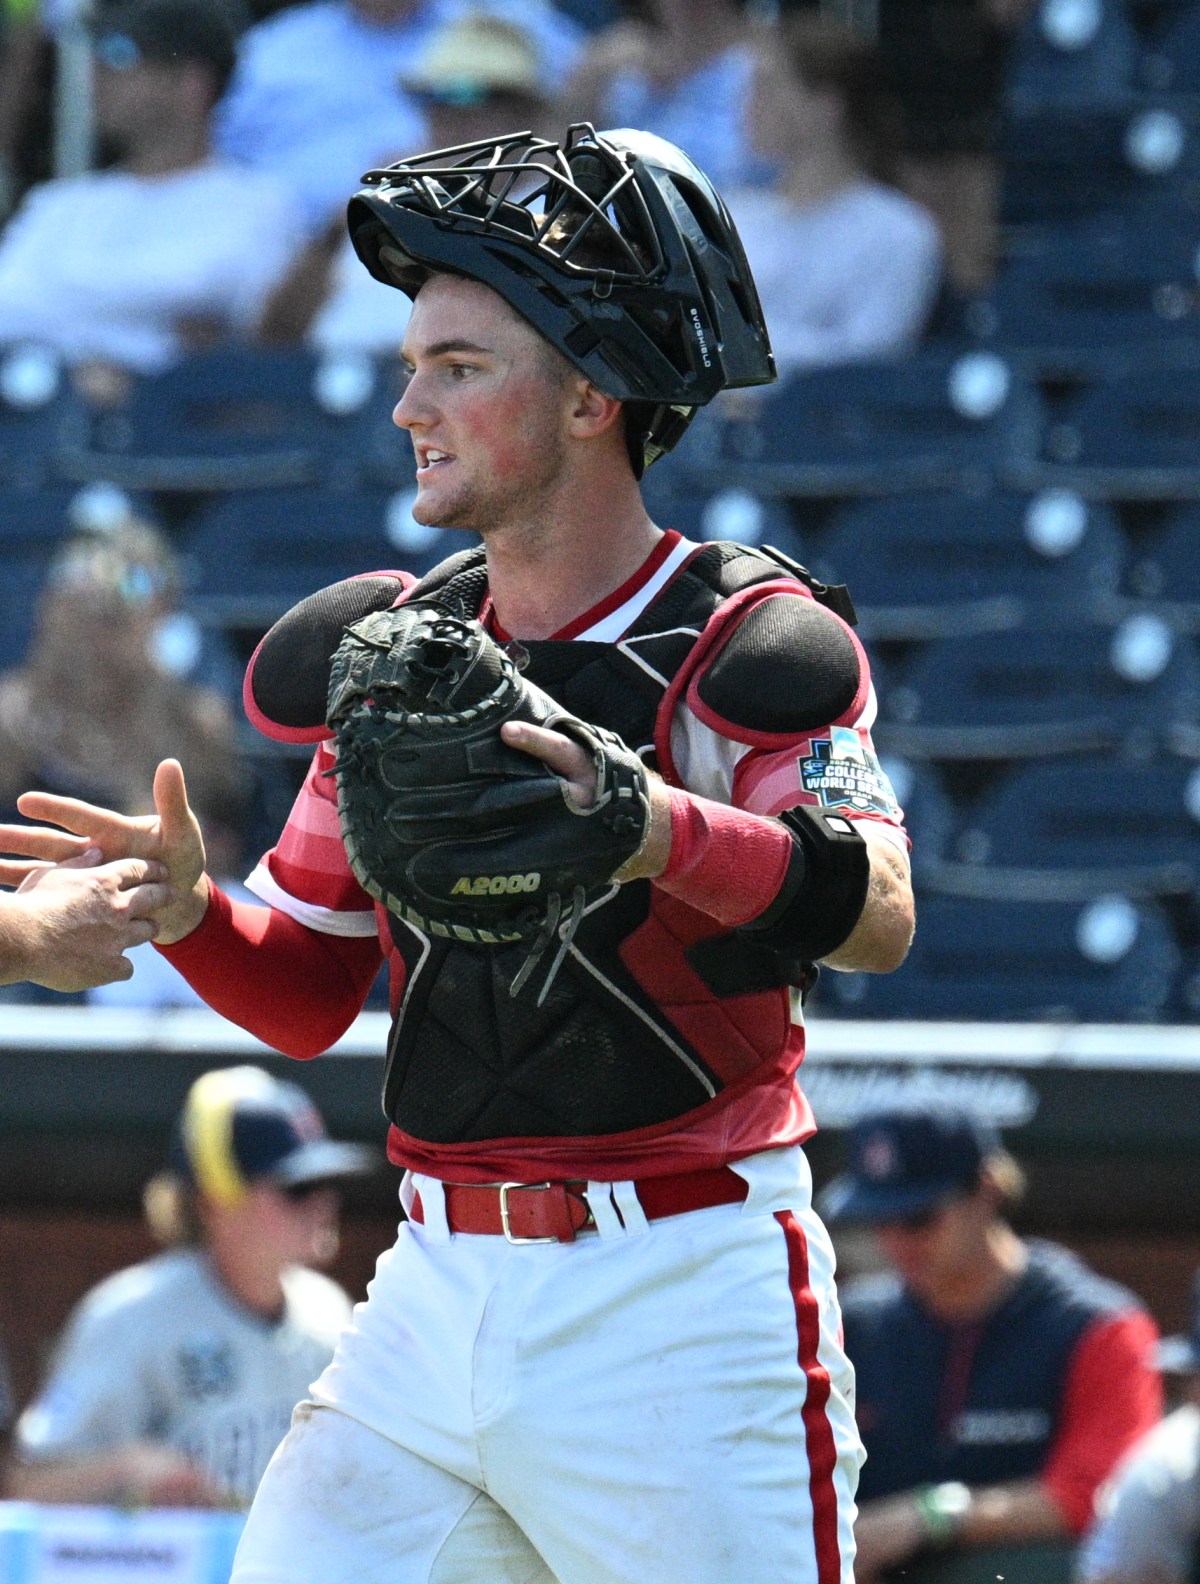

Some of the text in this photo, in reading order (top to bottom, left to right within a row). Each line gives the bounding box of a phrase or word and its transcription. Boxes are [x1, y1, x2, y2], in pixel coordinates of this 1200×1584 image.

[690, 308, 712, 368] EVOSHIELD
[806, 777, 856, 790] WORLD
[824, 765, 879, 787] COLLE
[449, 872, 541, 896] A2000
